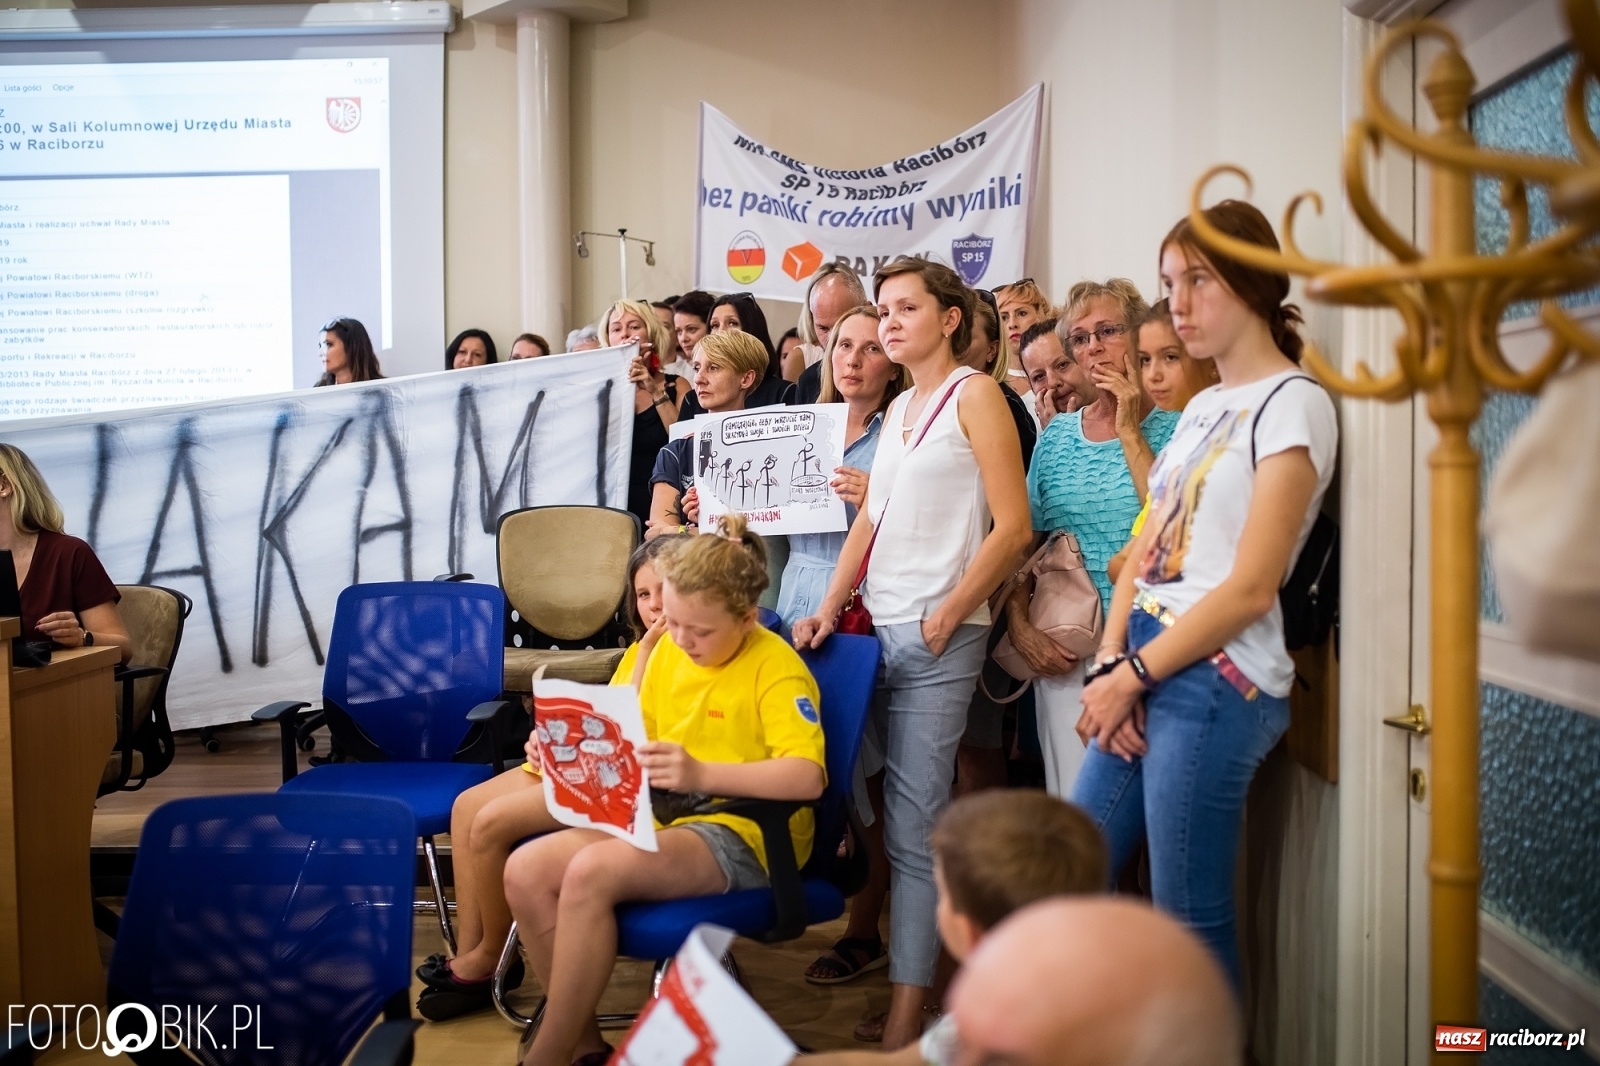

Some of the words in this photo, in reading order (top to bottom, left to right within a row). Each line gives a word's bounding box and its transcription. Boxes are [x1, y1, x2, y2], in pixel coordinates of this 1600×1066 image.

[22, 84, 42, 93] gości
[52, 84, 74, 92] Opcje
[31, 124, 43, 133] w
[48, 121, 77, 133] Sali
[83, 120, 178, 133] Kolumnowej
[184, 118, 238, 132] Urzędu
[244, 117, 292, 129] Miasta
[10, 142, 21, 150] w
[27, 138, 104, 150] Raciborzu
[780, 174, 810, 191] SP
[815, 182, 840, 198] 15
[843, 180, 928, 205] Racibórz
[739, 191, 812, 224] paniki
[818, 202, 915, 231] robimy
[926, 173, 1022, 222] wyniki
[35, 221, 76, 229] realizacji
[80, 220, 111, 228] uchwał
[114, 219, 137, 228] Rady
[953, 239, 992, 248] RACIBÓRZ
[962, 252, 973, 262] SP
[974, 252, 984, 262] 15
[7, 291, 52, 299] Powiatowi
[125, 289, 159, 298] (droga)
[34, 352, 76, 361] Rekreacji
[33, 371, 55, 379] Rady
[45, 380, 91, 388] Publicznej
[112, 378, 153, 386] Ryszarda
[30, 406, 91, 415] przyznawania
